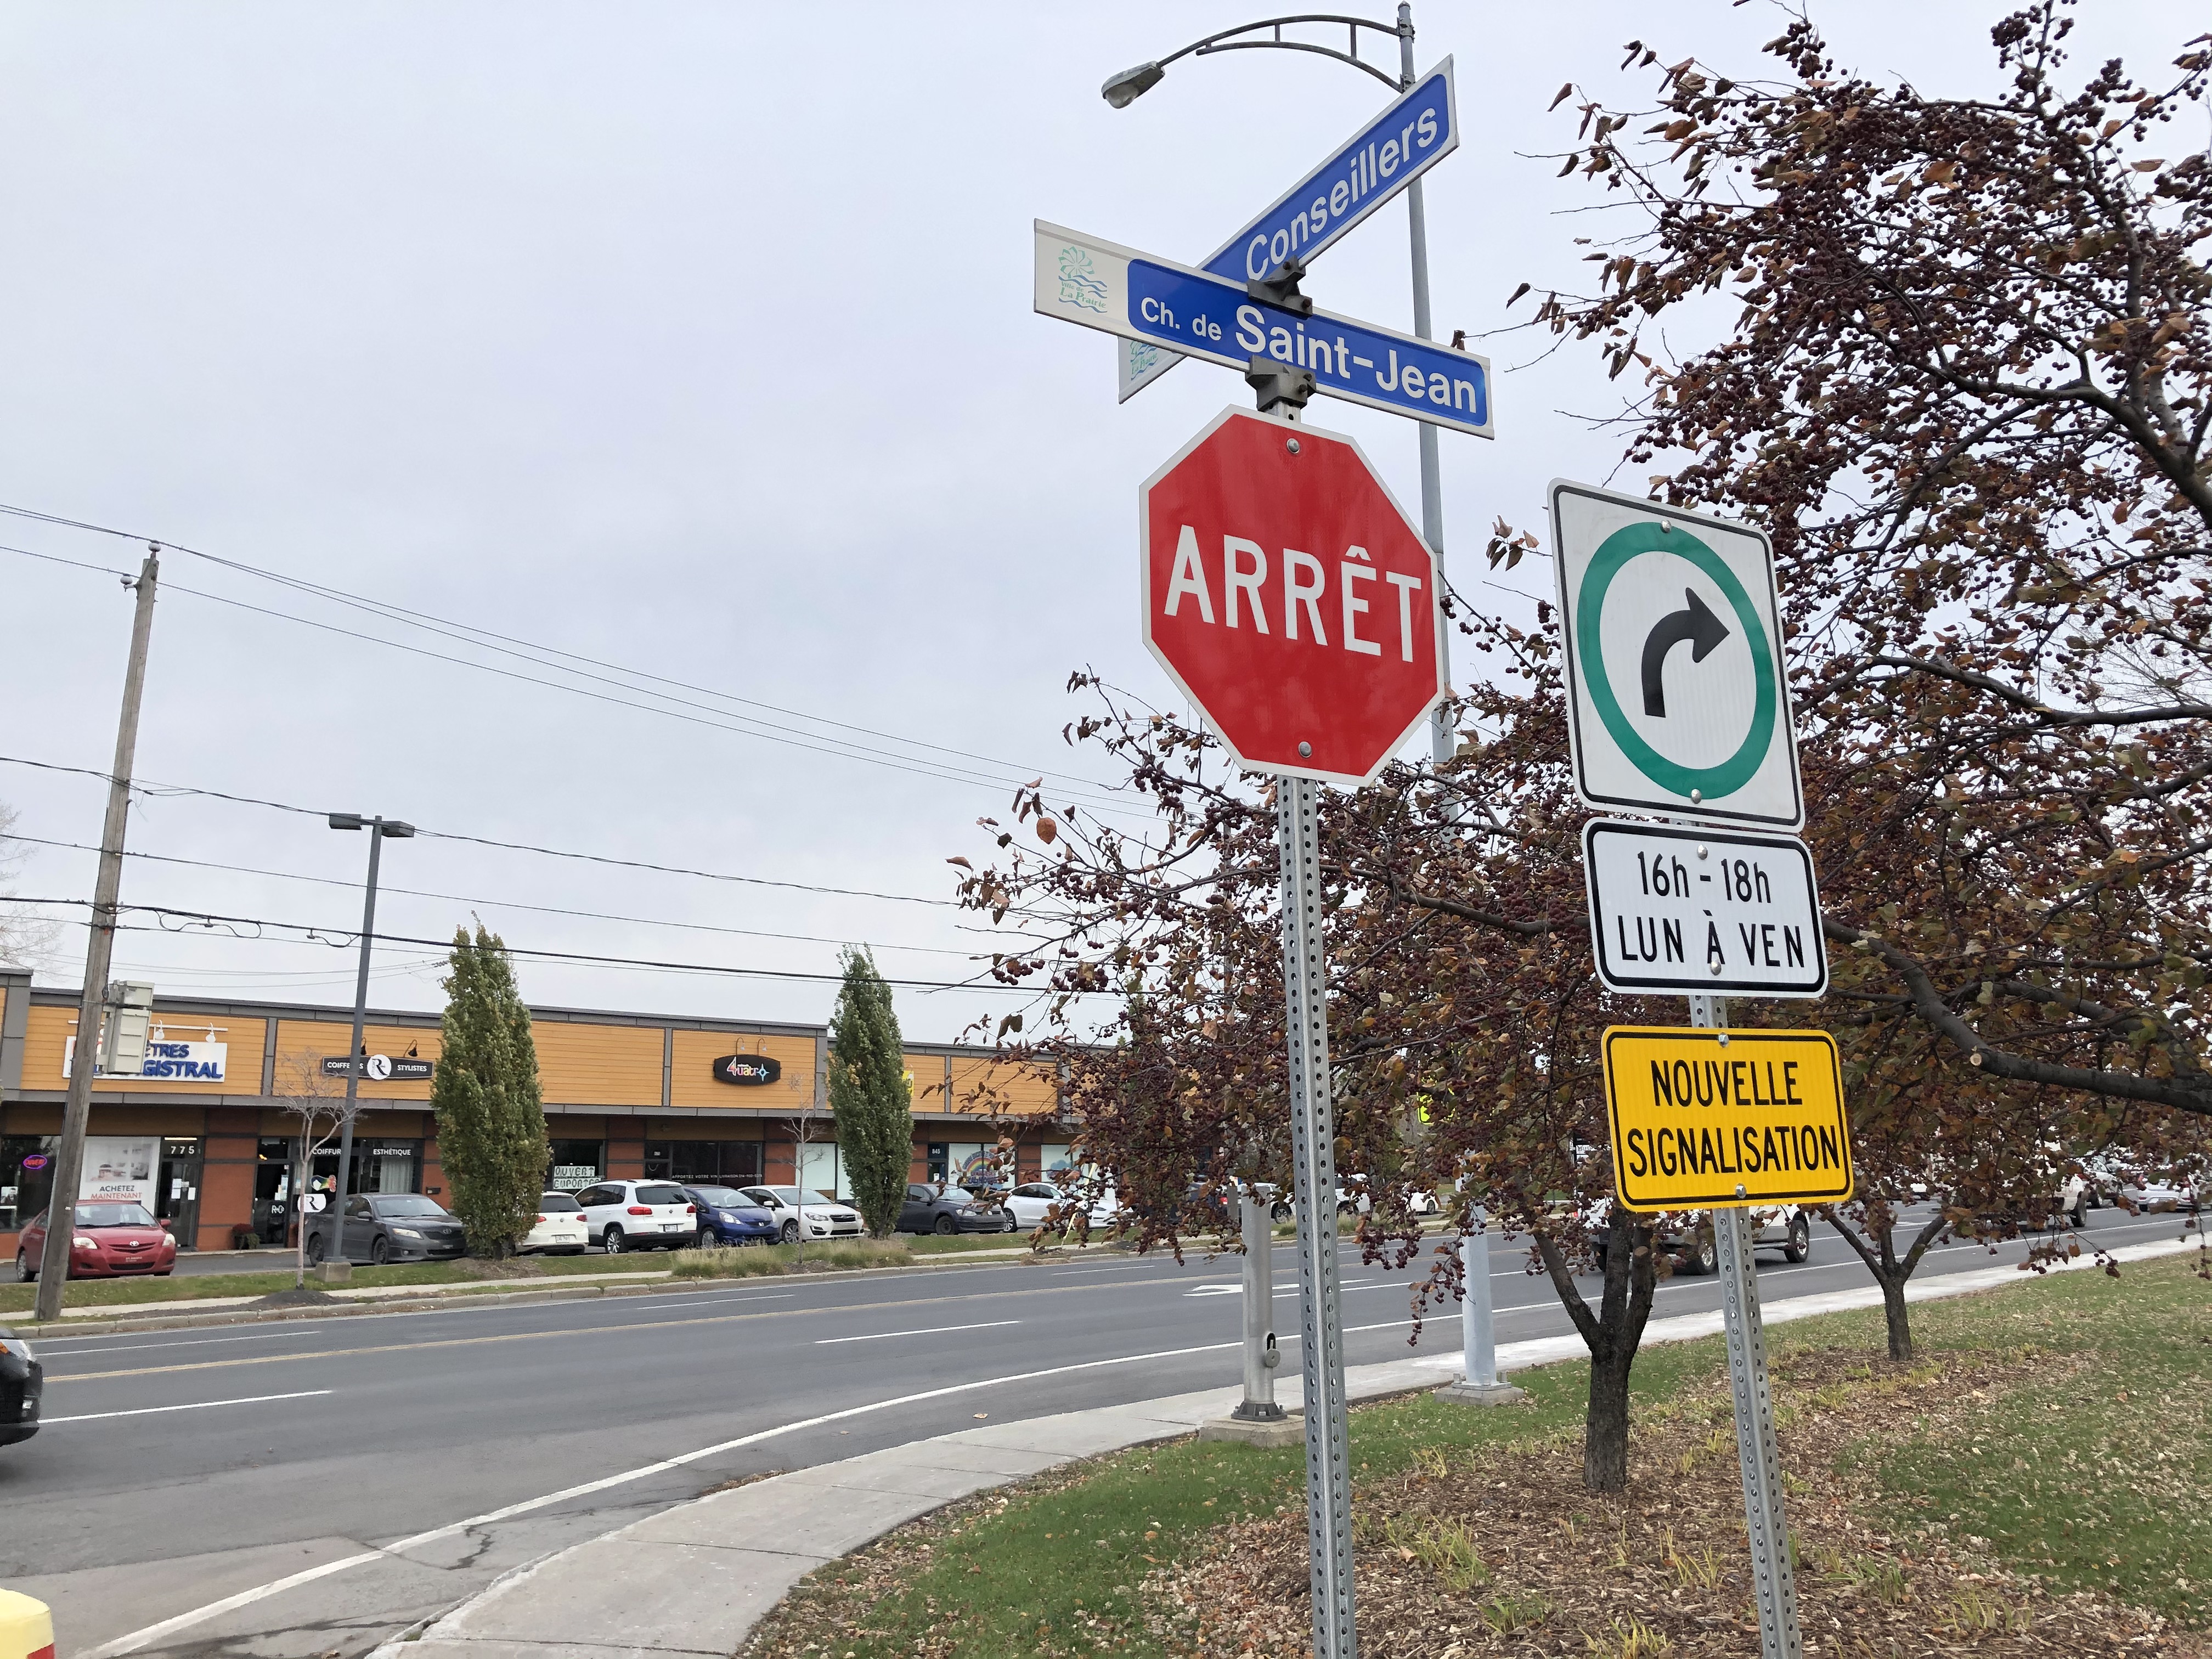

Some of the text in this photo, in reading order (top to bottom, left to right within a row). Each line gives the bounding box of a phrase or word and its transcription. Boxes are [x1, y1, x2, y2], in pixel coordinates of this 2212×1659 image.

[1246, 107, 1438, 281] Conseillers
[1060, 286, 1107, 308] La Prairie
[1141, 297, 1477, 414] Ch. de Saint-Jean
[1164, 524, 1422, 663] ARRÊT
[1617, 910, 1805, 968] LUN À VEN
[143, 1059, 223, 1079] GISTRAL
[1651, 1059, 1803, 1107] NOUVELLE
[171, 1146, 195, 1154] 775
[373, 1148, 411, 1156] ESTHÉTIQUE
[555, 1166, 594, 1177] OUVERT
[1627, 1125, 1840, 1177] SIGNALISATION
